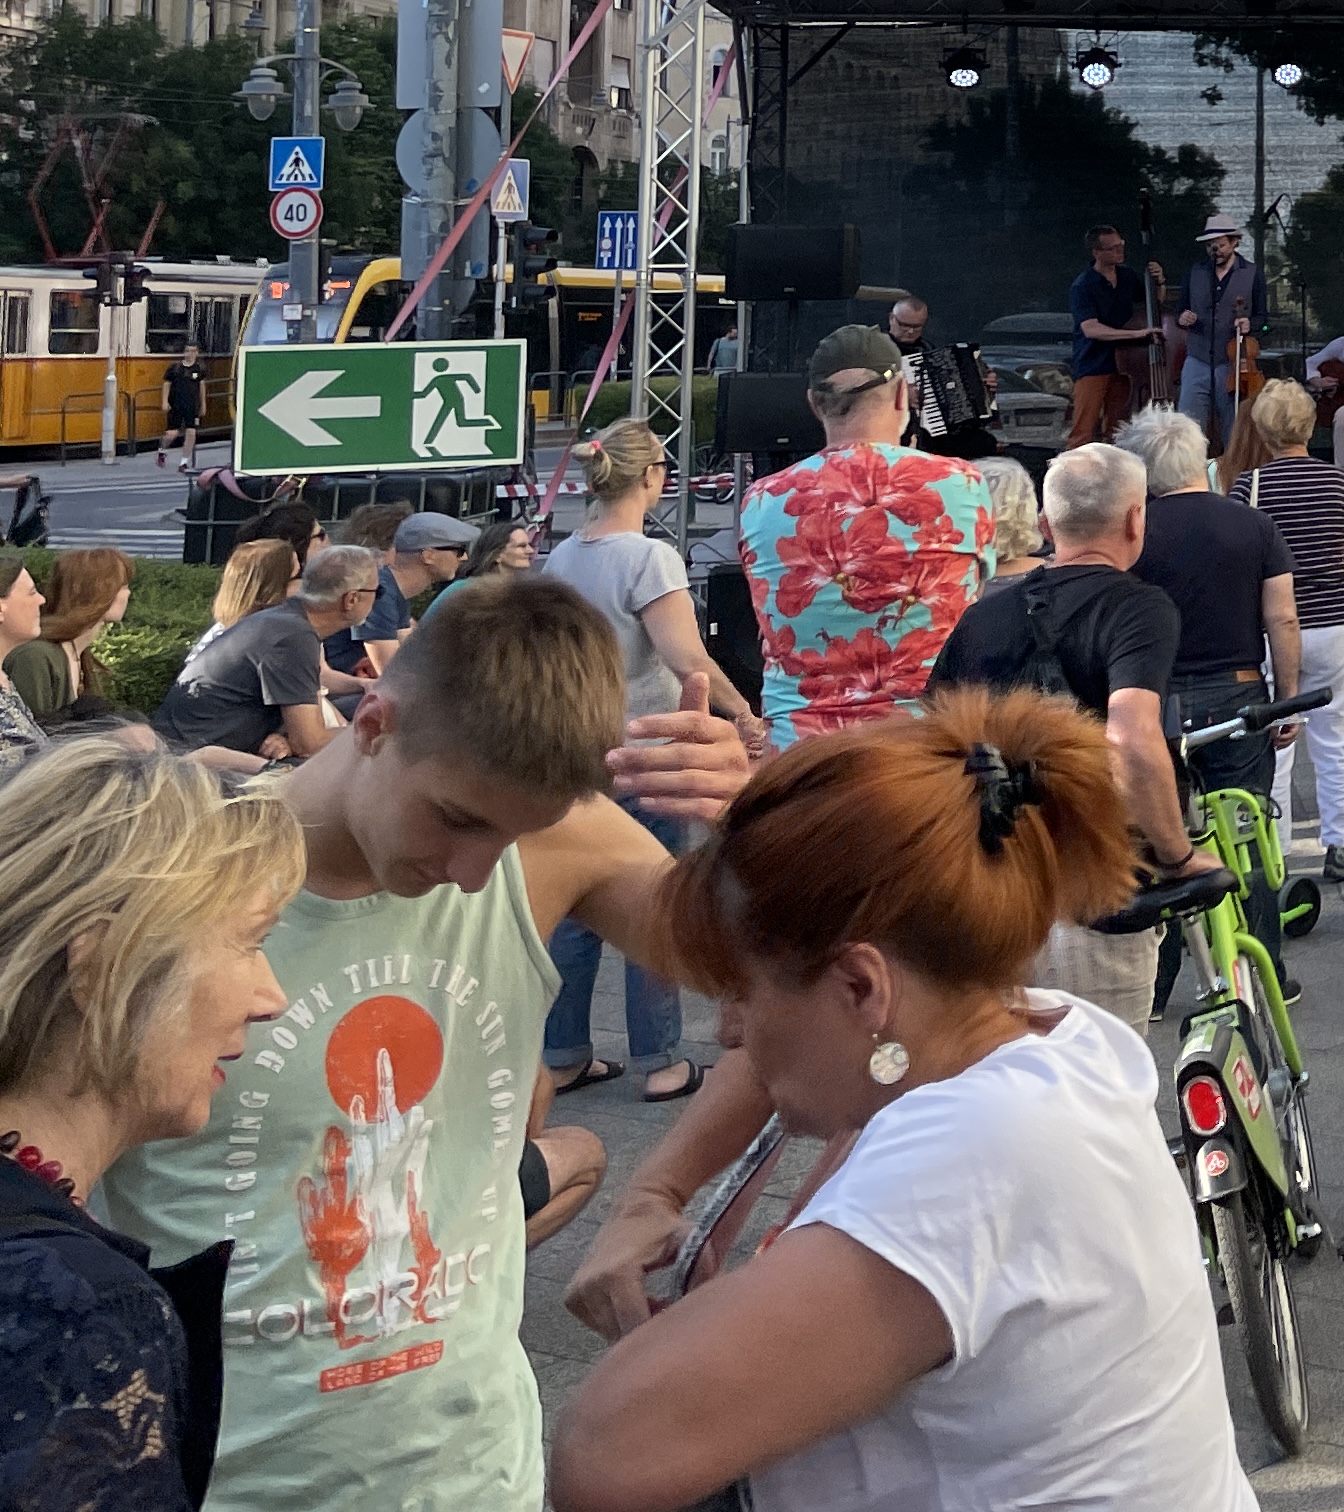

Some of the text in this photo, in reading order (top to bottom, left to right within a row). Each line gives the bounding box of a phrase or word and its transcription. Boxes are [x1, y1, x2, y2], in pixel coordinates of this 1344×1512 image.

[284, 203, 308, 222] 40
[224, 1090, 271, 1192] GOING
[254, 982, 334, 1075] DOWN
[343, 954, 413, 995] TILL
[428, 958, 480, 1007] THE
[475, 1000, 507, 1057] SUN
